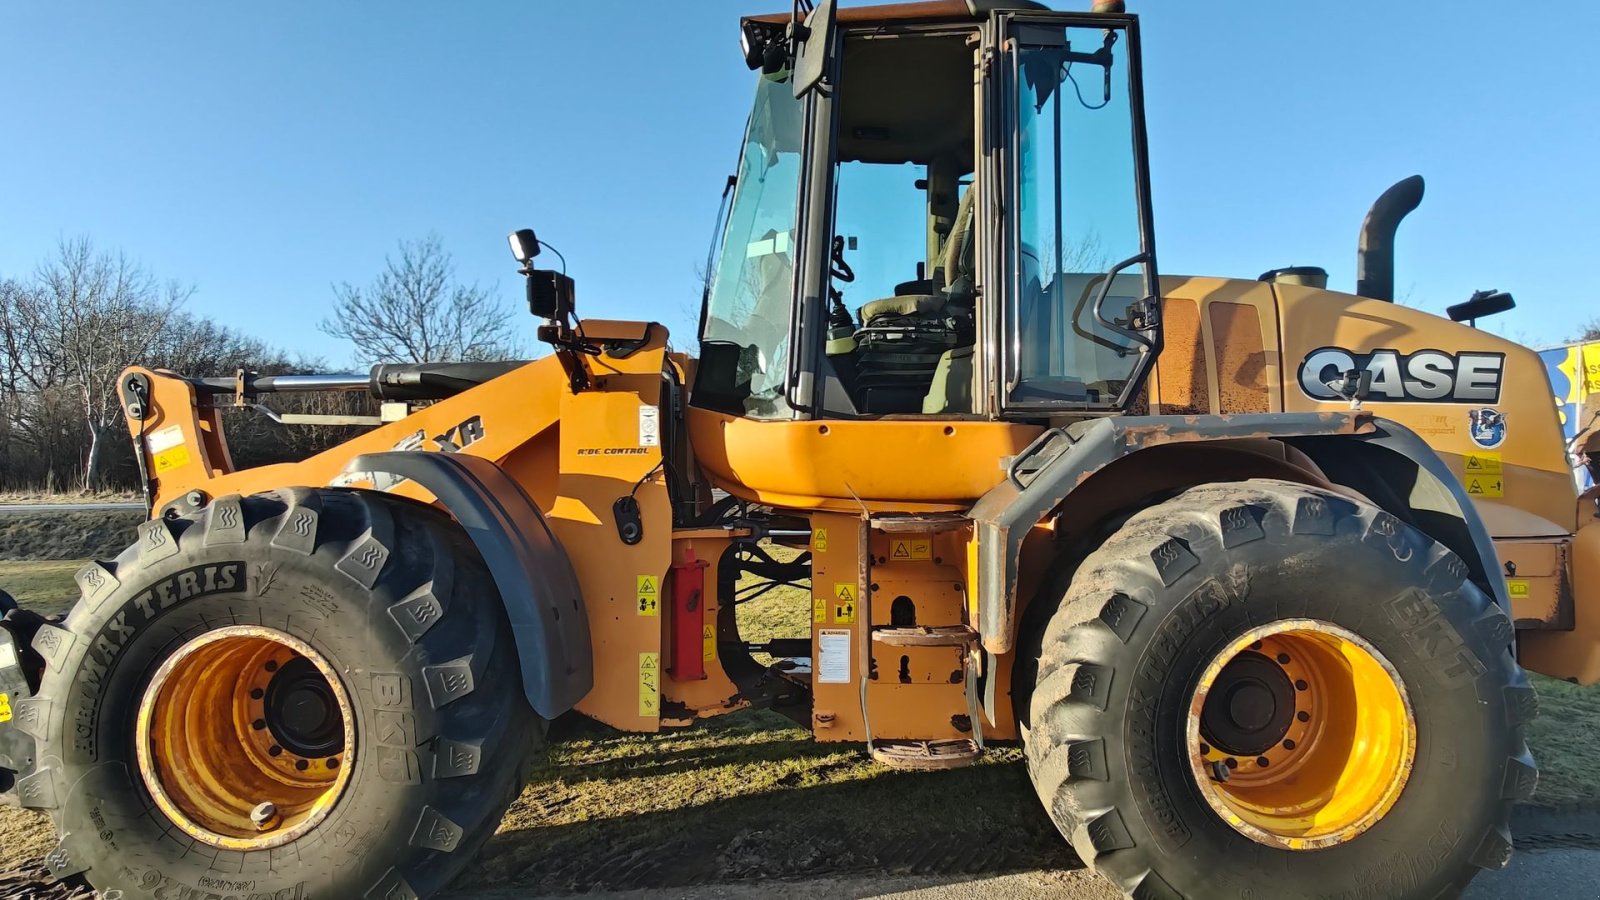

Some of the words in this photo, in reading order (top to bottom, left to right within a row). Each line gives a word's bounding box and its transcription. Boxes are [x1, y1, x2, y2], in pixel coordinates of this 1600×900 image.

[1302, 351, 1501, 400] CASE
[603, 447, 649, 455] CONTROL
[134, 564, 238, 620] TERIS
[1381, 586, 1488, 690] BKT
[370, 672, 422, 785] BKT
